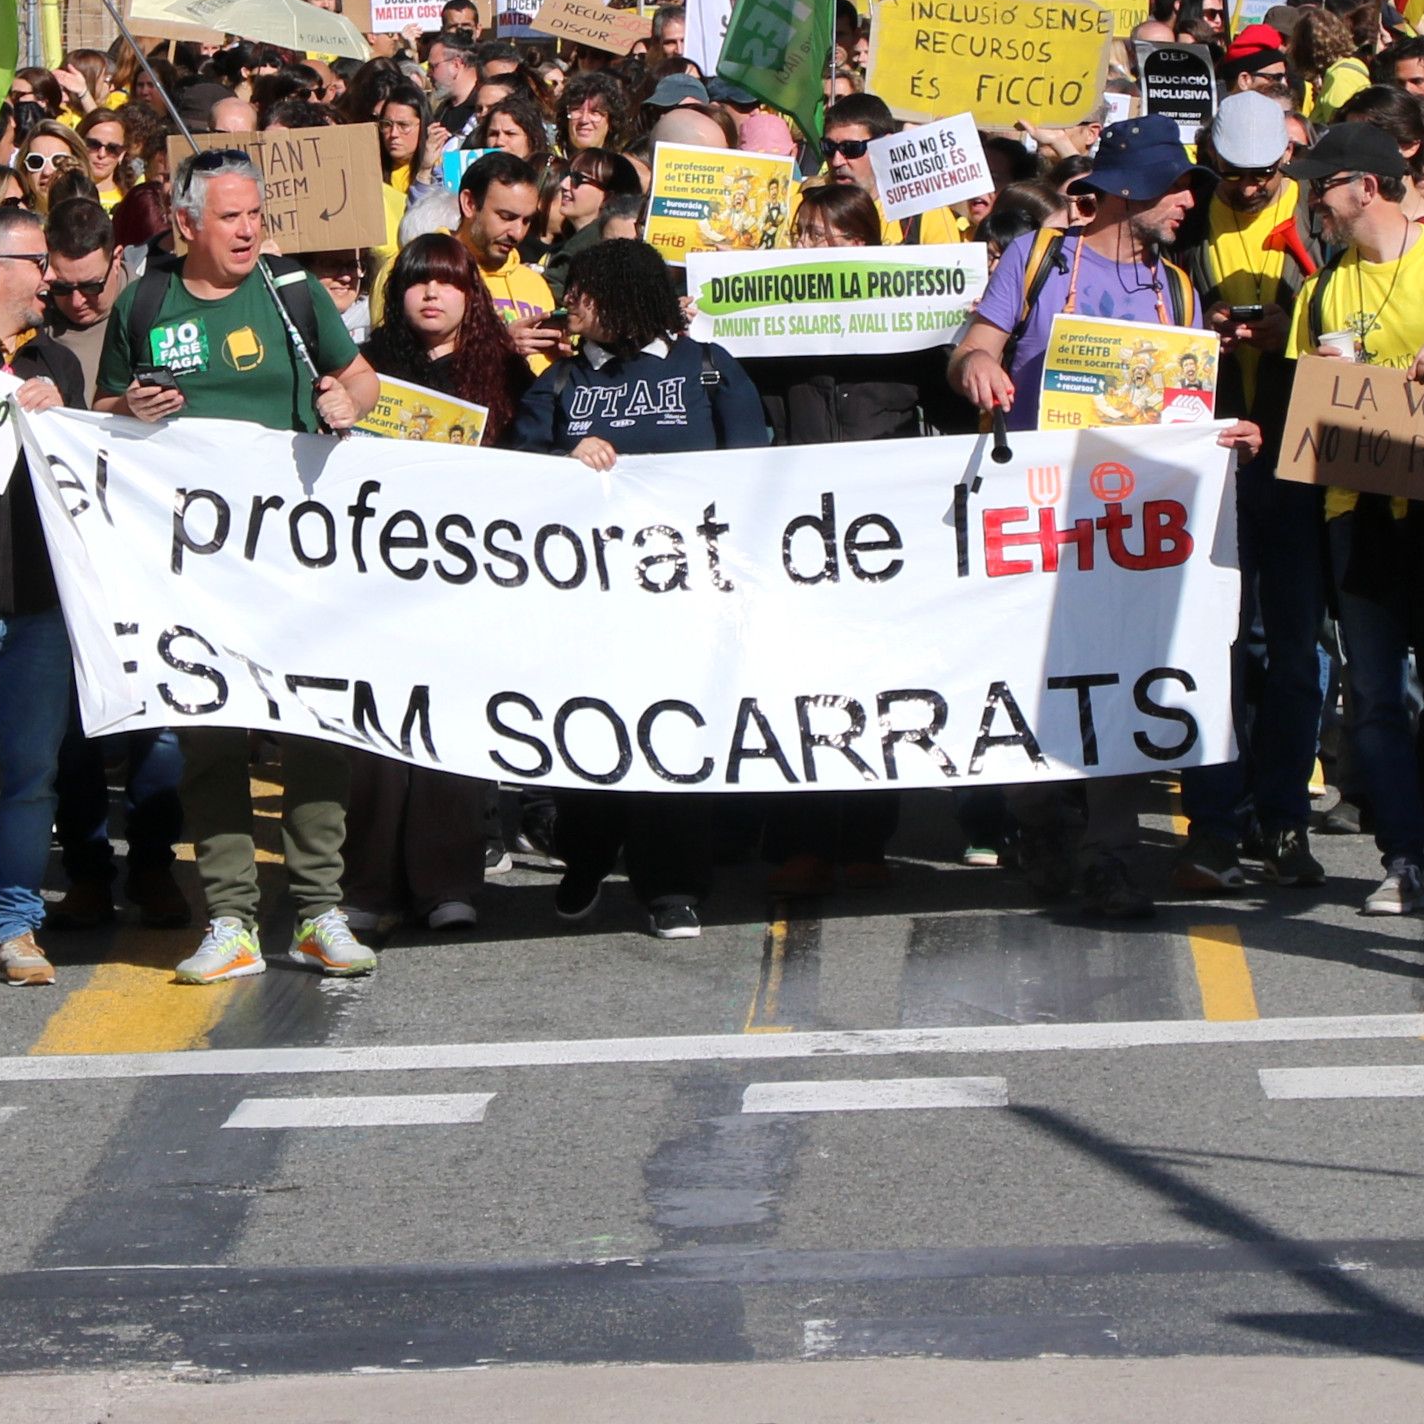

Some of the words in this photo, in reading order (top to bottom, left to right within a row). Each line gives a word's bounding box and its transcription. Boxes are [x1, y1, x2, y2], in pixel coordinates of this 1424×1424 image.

[375, 7, 415, 21] MATEIX
[1025, 7, 1111, 35] SENSE
[915, 29, 1053, 63] RECURSOS
[910, 70, 941, 100] ÉS
[976, 70, 1089, 107] FICCIÓ
[1148, 74, 1209, 86] EDUCACIÓ
[1149, 88, 1211, 101] INCLUSIVA
[889, 140, 918, 165] AIXÒ
[919, 136, 938, 156] NO
[939, 129, 957, 149] ÉS
[665, 174, 676, 182] de
[674, 161, 726, 174] professorat
[889, 152, 949, 185] INCLUSIÓ!
[949, 147, 968, 166] ÉS
[264, 176, 309, 201] STEM
[664, 185, 689, 193] estem
[690, 186, 733, 197] socarrats
[886, 162, 984, 206] SUPERVIVÈNCIA!
[712, 272, 835, 305] DIGNIFIQUEM
[839, 272, 863, 300] LA
[867, 260, 966, 298] PROFESSIÓ
[158, 323, 199, 350] JO
[712, 316, 762, 338] AMUNT
[764, 315, 787, 336] ELS
[788, 313, 845, 338] SALARIS,
[848, 312, 889, 334] AVALL
[891, 311, 914, 333] LES
[159, 340, 202, 362] FARÉ
[1058, 345, 1070, 354] de
[1071, 345, 1111, 358] l'EHTB
[1068, 333, 1122, 346] professorat
[1056, 357, 1083, 366] estem
[1084, 359, 1131, 371] socarrats
[570, 376, 687, 420] UTAH
[1062, 382, 1095, 393] recursos
[1331, 376, 1379, 412] LA
[1292, 426, 1341, 464] NO
[1354, 426, 1391, 468] HO
[171, 479, 735, 594] professorat
[781, 491, 905, 585] de
[485, 666, 1200, 785] SOCARRATS
